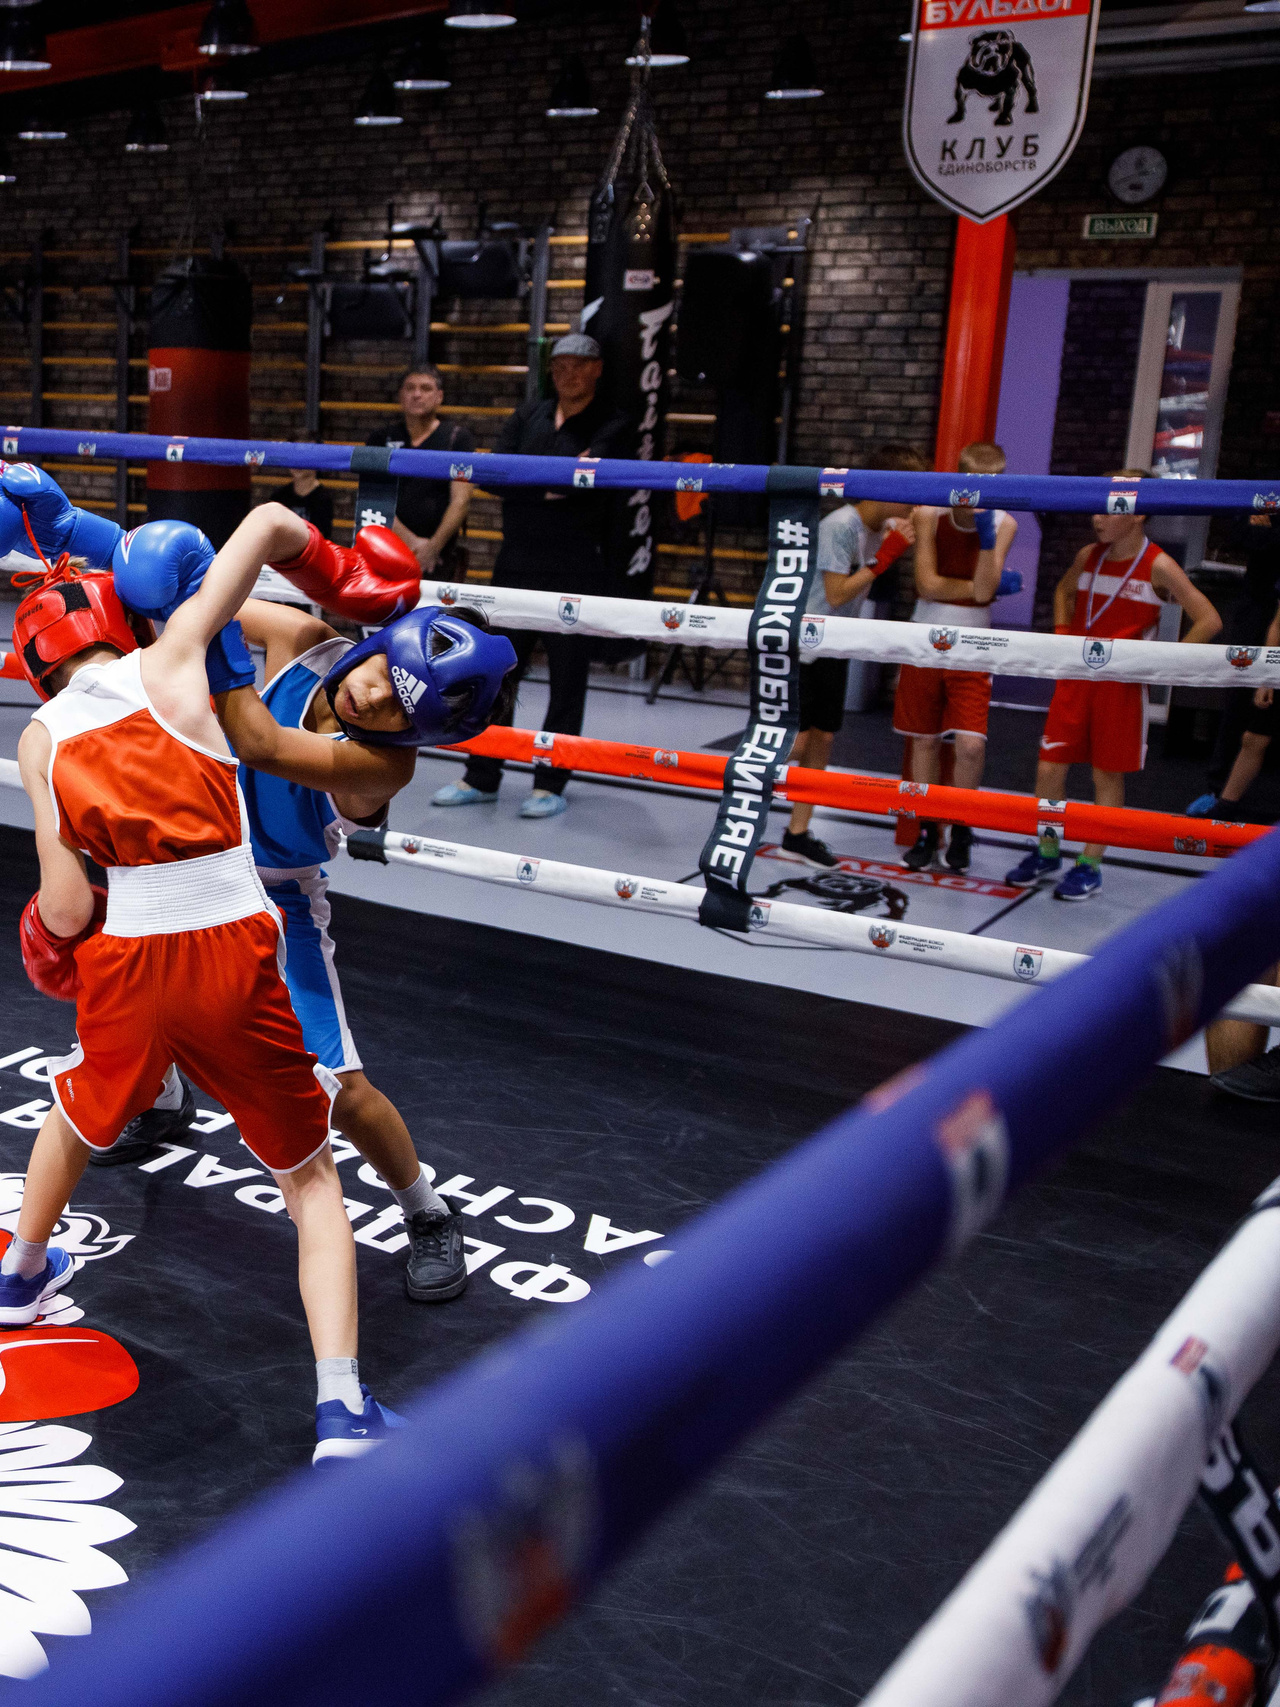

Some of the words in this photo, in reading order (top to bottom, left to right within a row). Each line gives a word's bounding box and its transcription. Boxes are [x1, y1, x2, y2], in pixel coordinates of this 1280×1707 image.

[941, 134, 1039, 160] КЛУБ
[938, 159, 1036, 176] ЕДИНОБОРСТВ
[391, 665, 415, 714] adidas
[708, 519, 810, 892] #БОКСОБЪЕДИНЯЕТ
